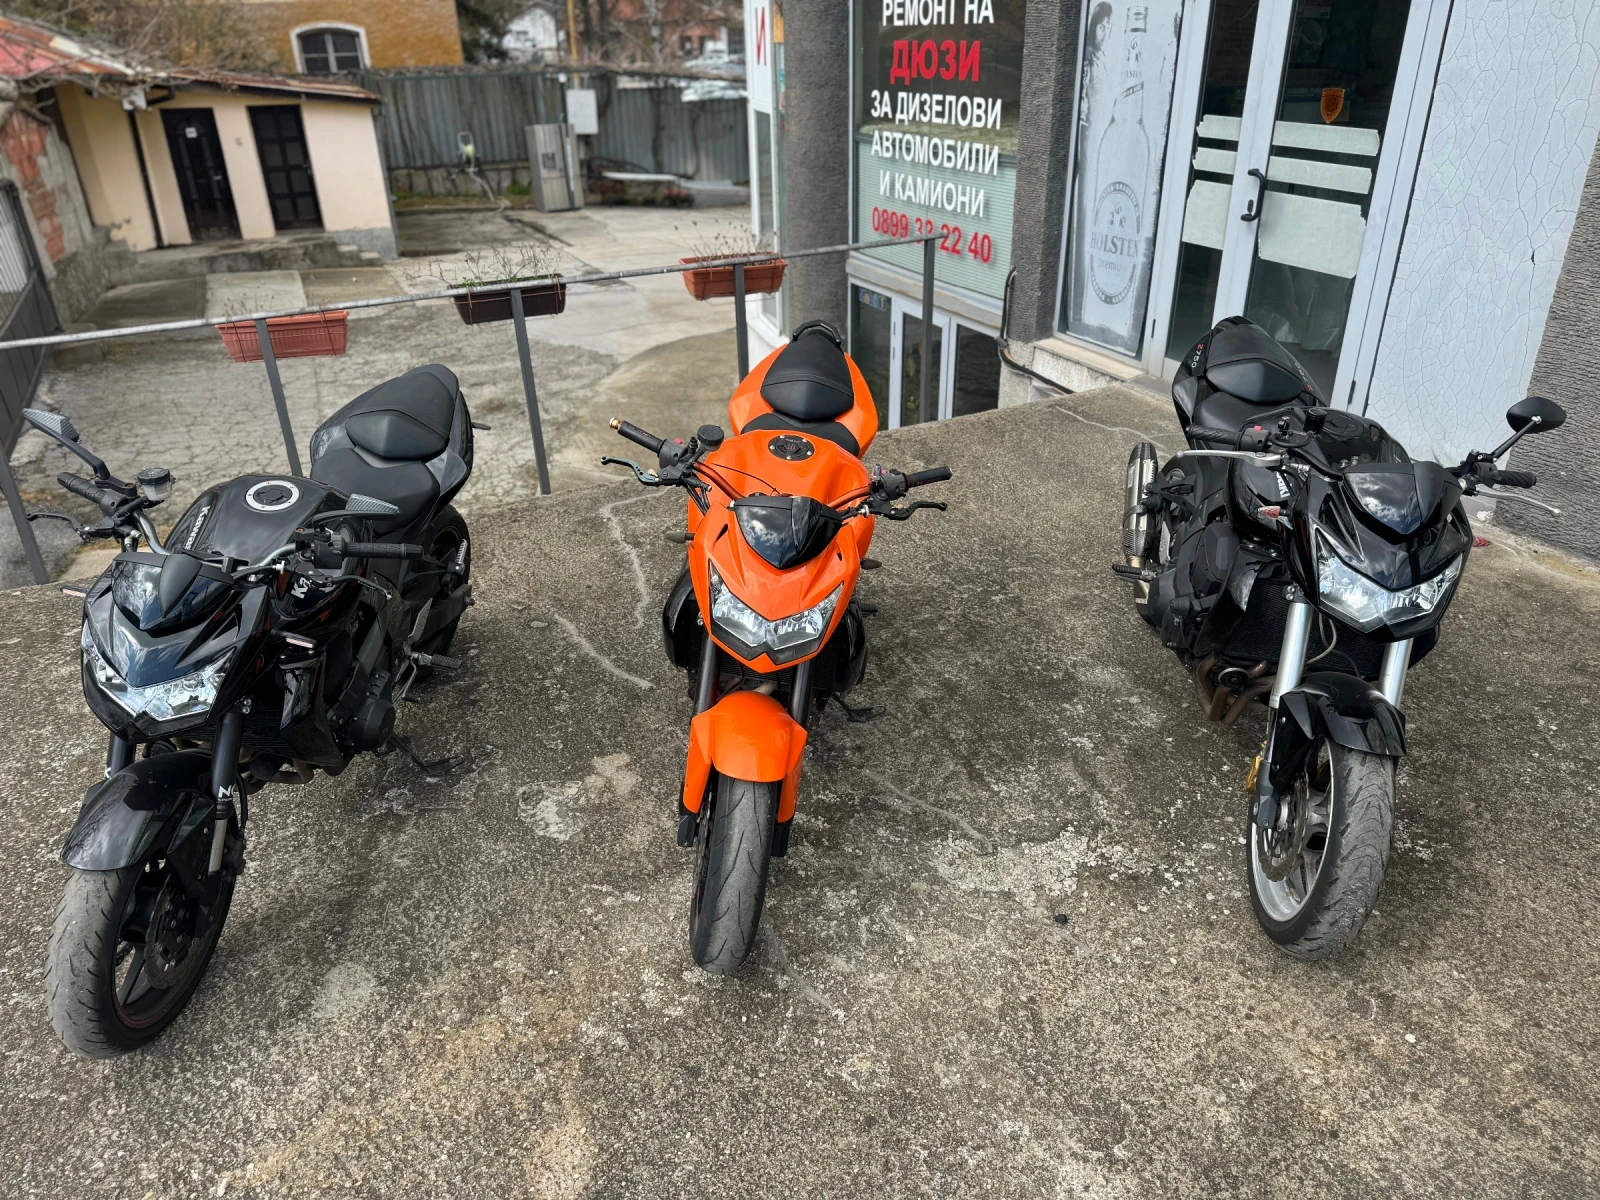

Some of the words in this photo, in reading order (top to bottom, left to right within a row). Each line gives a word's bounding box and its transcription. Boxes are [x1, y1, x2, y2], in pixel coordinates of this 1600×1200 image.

[964, 0, 995, 25] НА
[889, 39, 981, 85] ДЮЗИ
[871, 89, 892, 119] ЗА
[895, 91, 1002, 130] ДИЗЕЛОВИ
[871, 130, 999, 176] АВТОМОБИЛИ
[879, 169, 890, 197] И
[894, 174, 985, 218] КАМИОНИ
[872, 206, 908, 238] 0899
[940, 223, 962, 255] 22
[968, 231, 992, 263] 40
[1090, 230, 1139, 258] HOLSTEN
[1191, 343, 1204, 368] Z750
